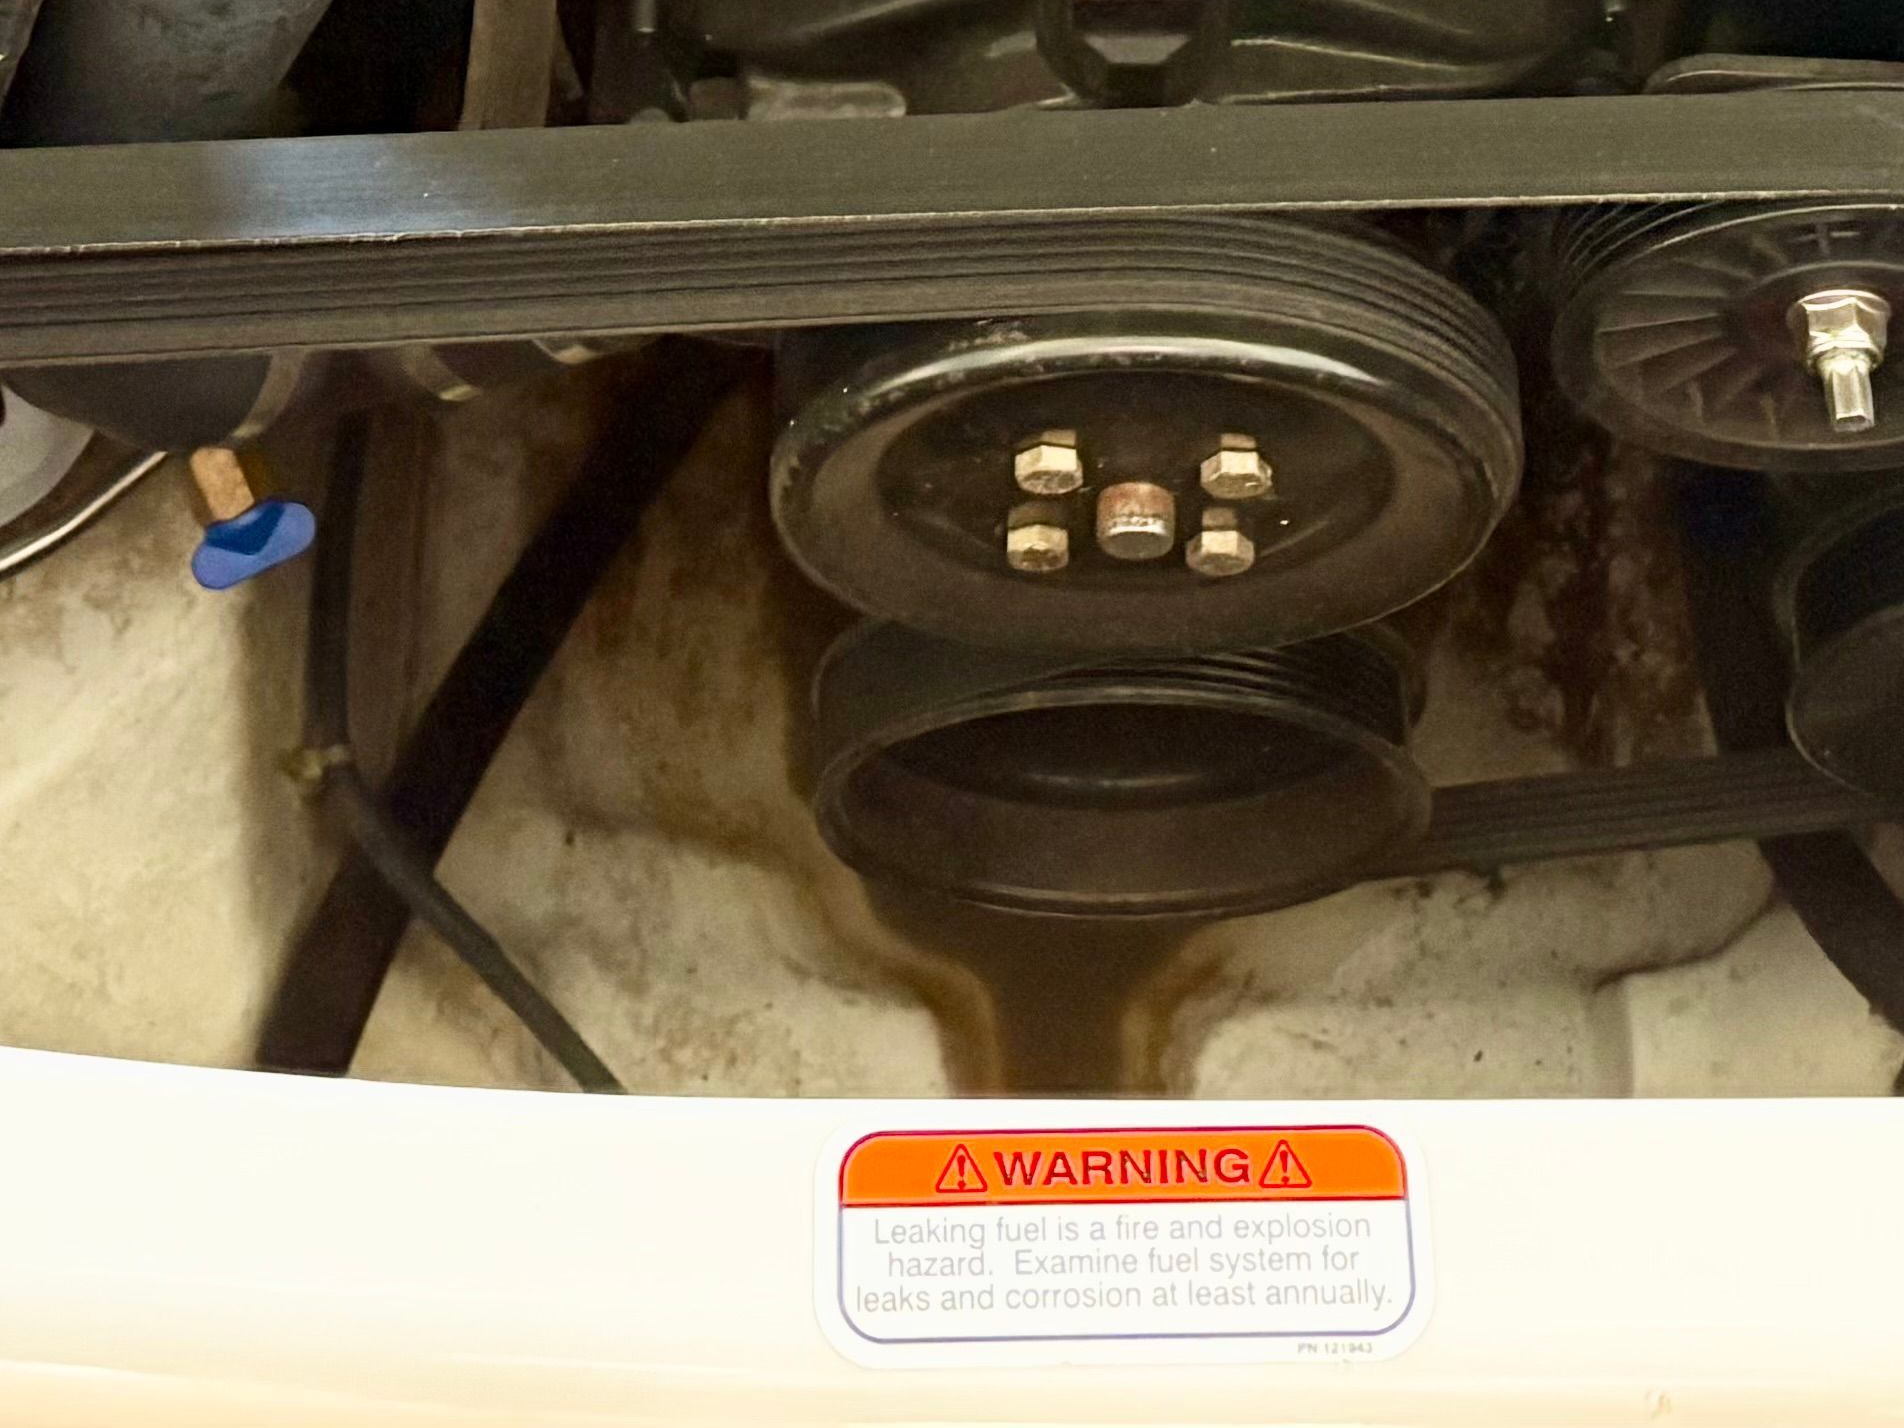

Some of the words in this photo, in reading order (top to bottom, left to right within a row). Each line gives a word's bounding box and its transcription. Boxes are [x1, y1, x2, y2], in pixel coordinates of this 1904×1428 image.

[992, 1147, 1252, 1187] WARNING
[873, 1217, 986, 1250] Leaking
[995, 1216, 1047, 1244] fuel
[1057, 1217, 1080, 1242] is
[1088, 1221, 1106, 1242] a
[1115, 1215, 1161, 1241] fire
[1169, 1214, 1224, 1240] and
[1233, 1214, 1372, 1247] explosion
[887, 1251, 995, 1279] hazard.
[1014, 1248, 1138, 1276] Examine
[1147, 1247, 1200, 1274] fuel
[1209, 1249, 1312, 1278] system
[1321, 1245, 1360, 1271] for
[856, 1285, 932, 1314] leaks
[940, 1284, 995, 1311] and
[1005, 1281, 1143, 1310] corrosion
[1152, 1282, 1178, 1308] at
[1188, 1280, 1256, 1307] least
[1264, 1278, 1394, 1310] annually.
